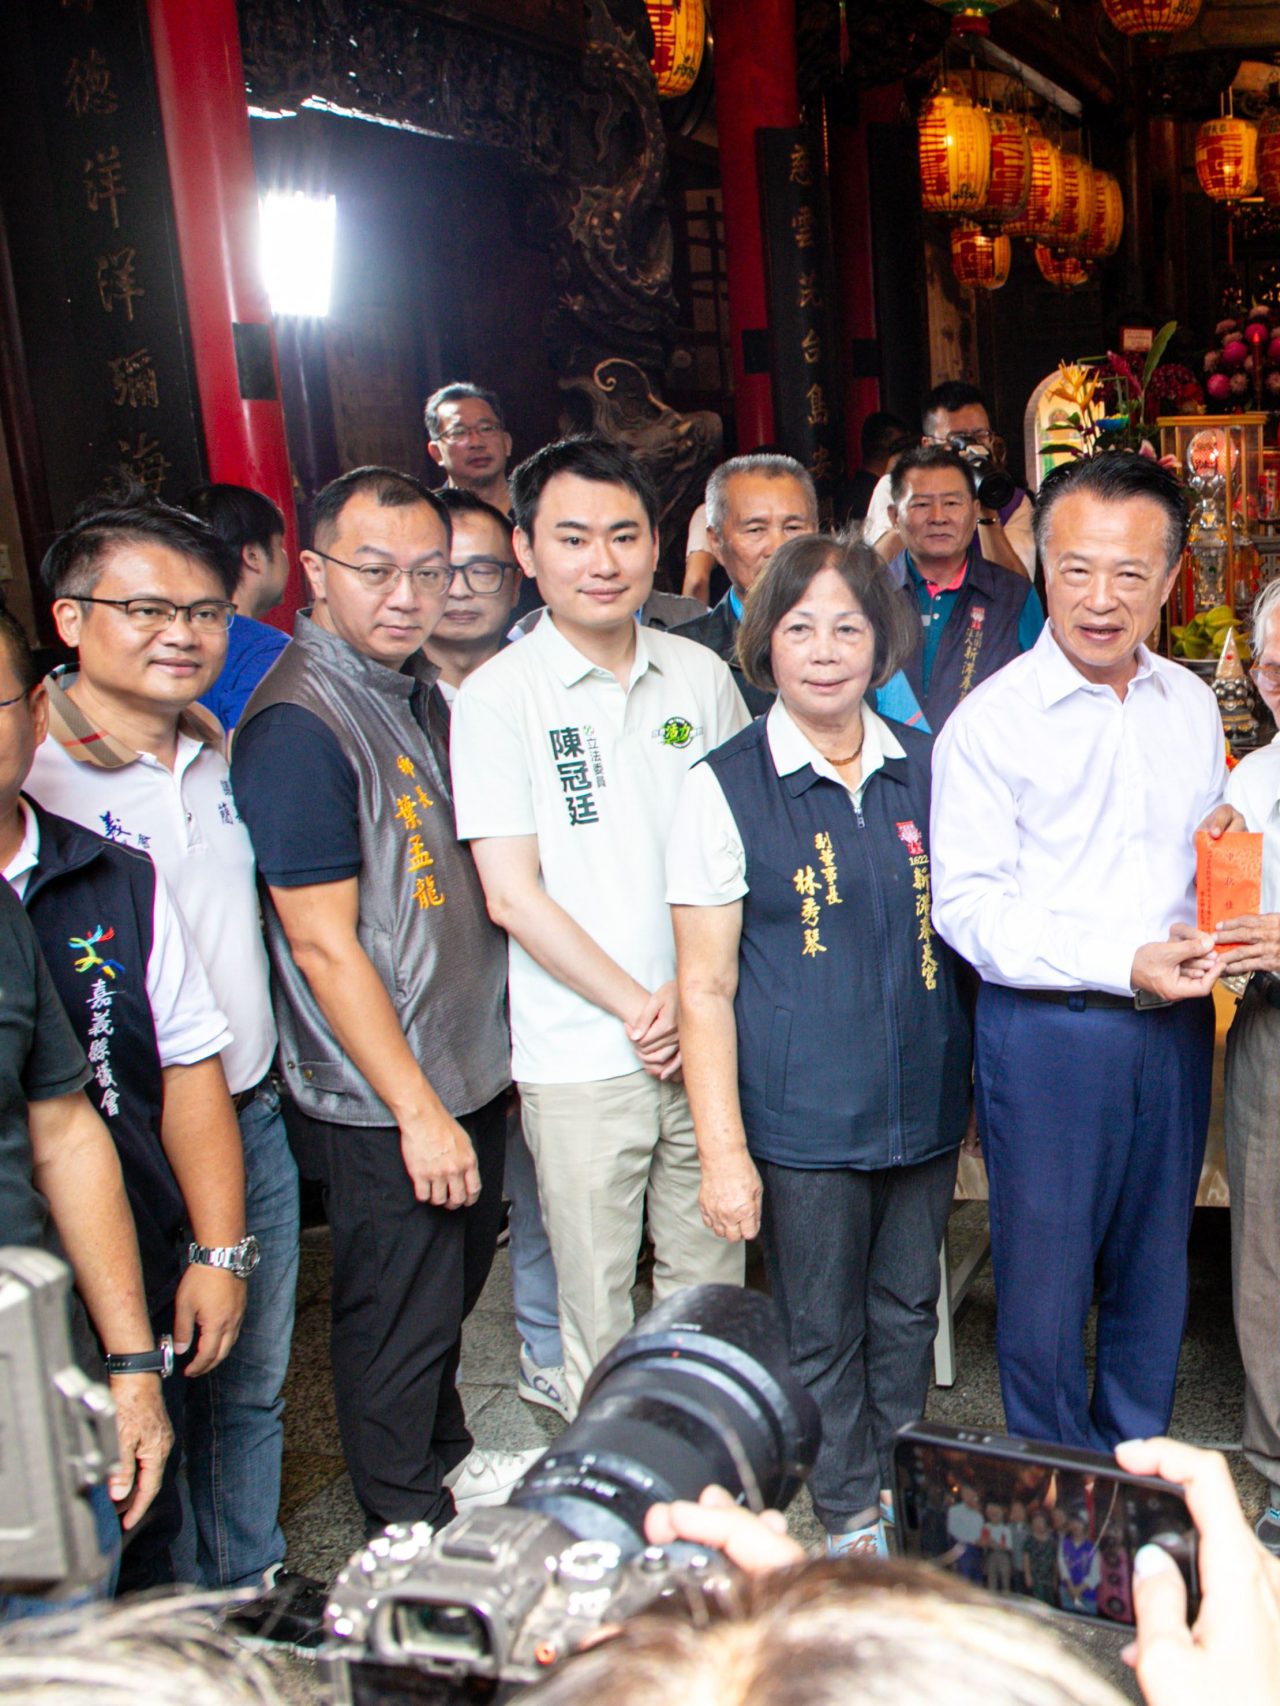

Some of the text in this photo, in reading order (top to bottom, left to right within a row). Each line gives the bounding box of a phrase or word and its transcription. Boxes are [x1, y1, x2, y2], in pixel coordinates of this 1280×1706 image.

[396, 755, 434, 809] 鄉長
[548, 726, 600, 827] 陳冠廷
[394, 794, 446, 911] 葉孟龍
[814, 831, 844, 906] 副董事長
[908, 854, 930, 867] 1622
[793, 865, 828, 958] 林秀琴
[85, 977, 124, 1117] 嘉義縣議會
